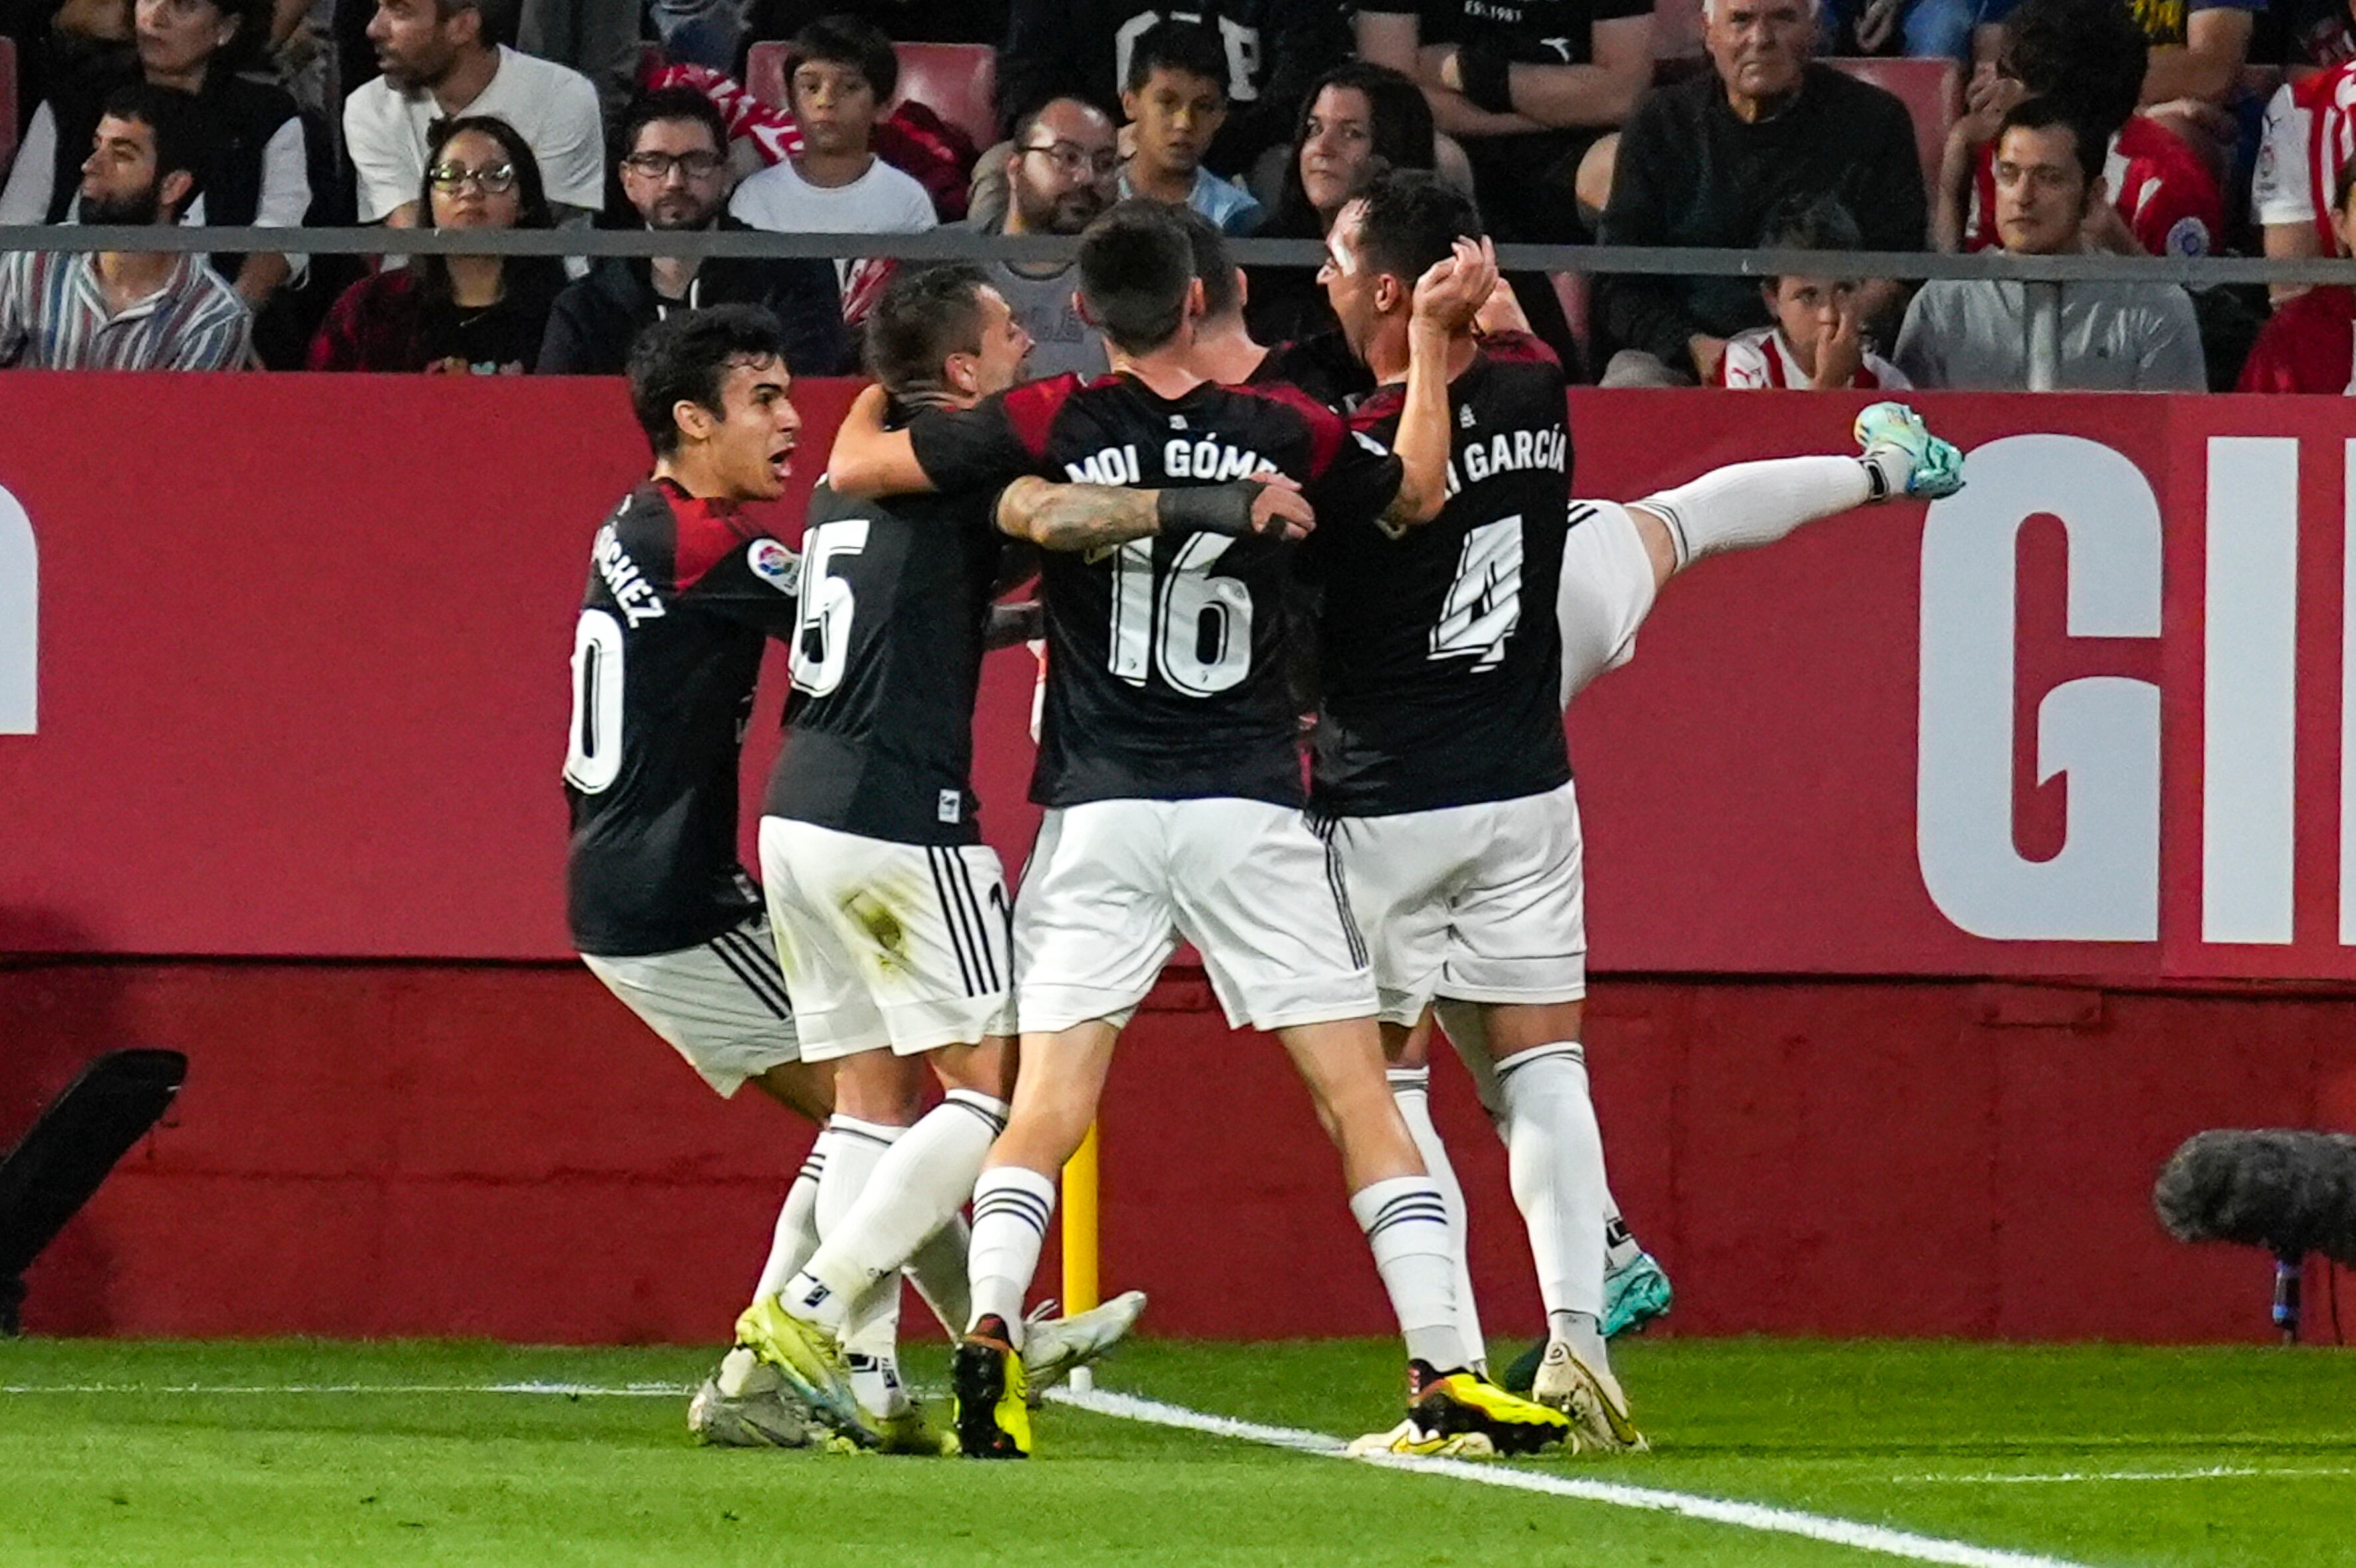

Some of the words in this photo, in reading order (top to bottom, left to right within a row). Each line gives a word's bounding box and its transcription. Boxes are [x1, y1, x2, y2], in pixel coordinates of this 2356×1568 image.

[1065, 444, 1140, 486] MOI
[1464, 423, 1567, 483] GARCÍA
[1108, 531, 1254, 698] 16
[1426, 513, 1524, 674] 4
